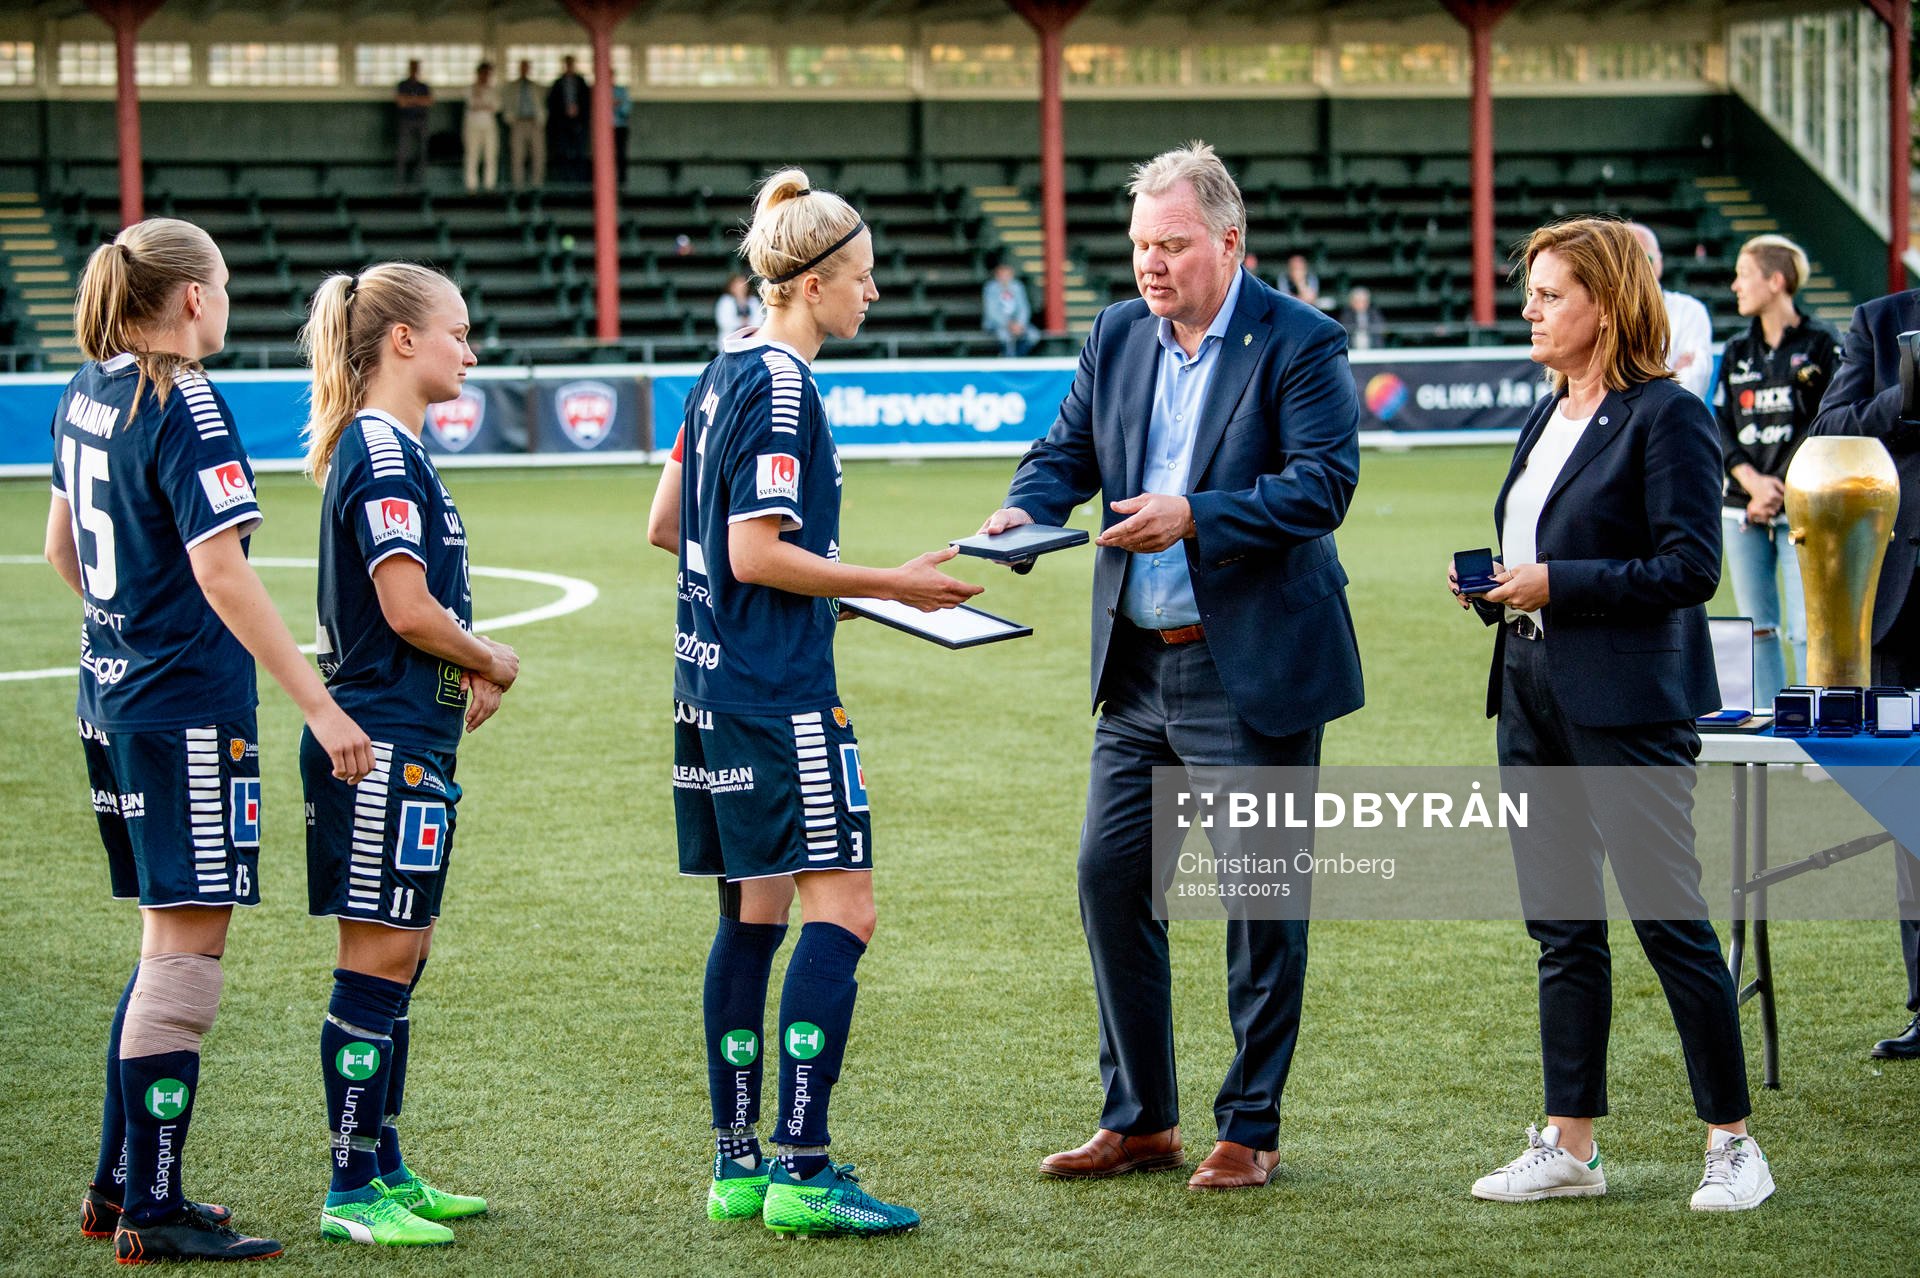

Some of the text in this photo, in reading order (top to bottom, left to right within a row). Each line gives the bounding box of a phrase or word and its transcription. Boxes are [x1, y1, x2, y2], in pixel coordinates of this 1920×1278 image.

[1416, 384, 1494, 410] OLIKA
[61, 434, 117, 600] 15
[851, 832, 863, 863] 3
[390, 886, 414, 920] 11
[335, 1086, 365, 1168] Lundbergs
[730, 1070, 751, 1136] Lundbergs
[787, 1064, 813, 1137] Lundbergs
[150, 1125, 177, 1201] Lundbergs
